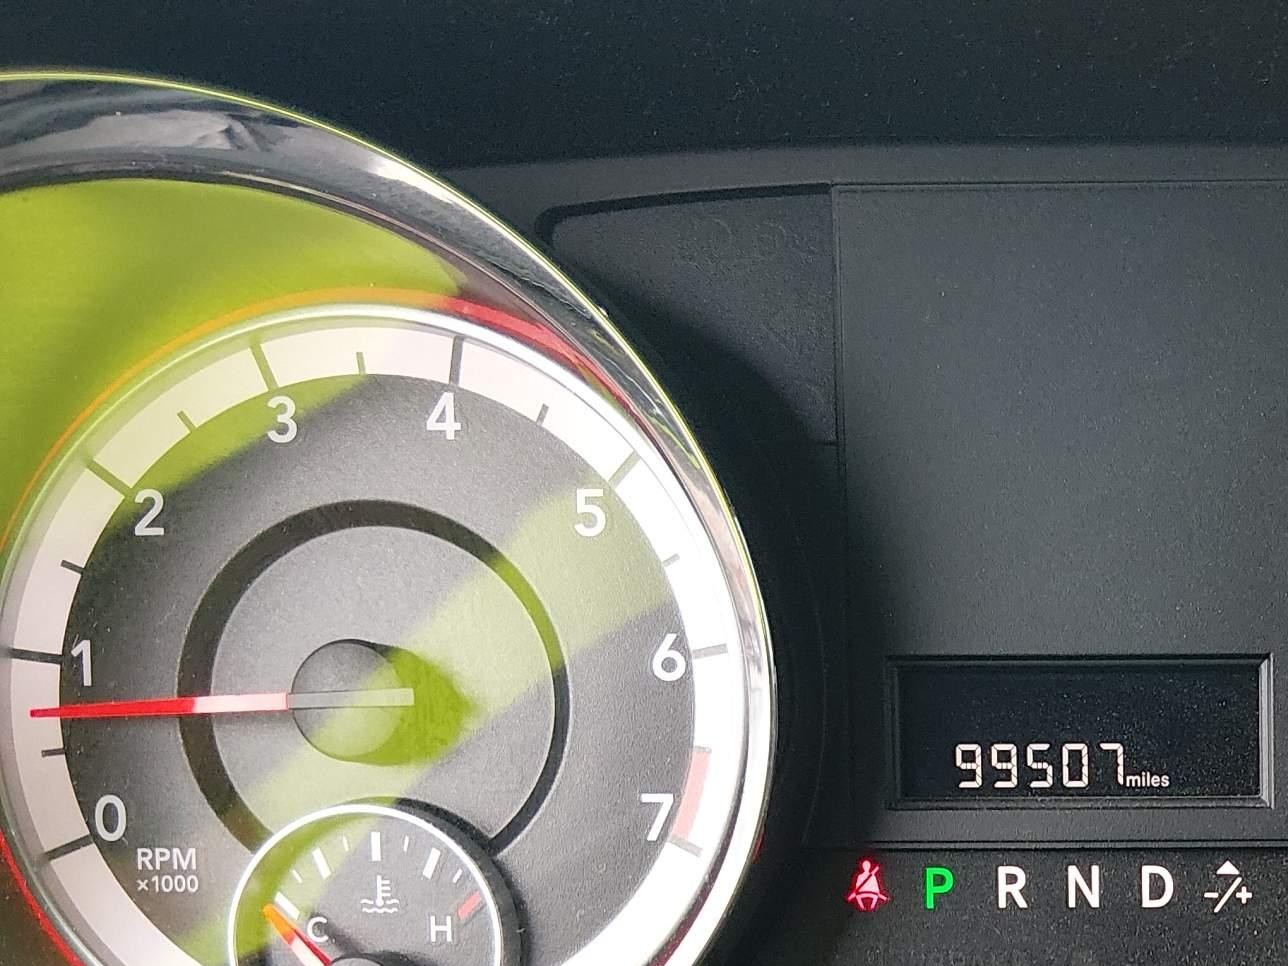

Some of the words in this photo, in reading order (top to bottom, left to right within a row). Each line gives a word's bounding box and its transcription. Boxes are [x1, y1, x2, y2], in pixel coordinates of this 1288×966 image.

[267, 397, 298, 443] 3
[426, 392, 461, 440] 4
[133, 489, 166, 536] 2
[575, 488, 607, 537] 5
[70, 640, 93, 687] 1
[651, 633, 686, 681] 6
[955, 743, 1124, 788] 99507
[1125, 773, 1170, 788] miles
[95, 797, 127, 842] 0
[640, 793, 676, 842] 7
[136, 848, 198, 870] RPM
[924, 867, 954, 909] P
[998, 866, 1028, 908] R
[1068, 866, 1100, 908] N
[1142, 866, 1174, 908] D
[307, 919, 327, 943] C
[429, 918, 454, 943] H
